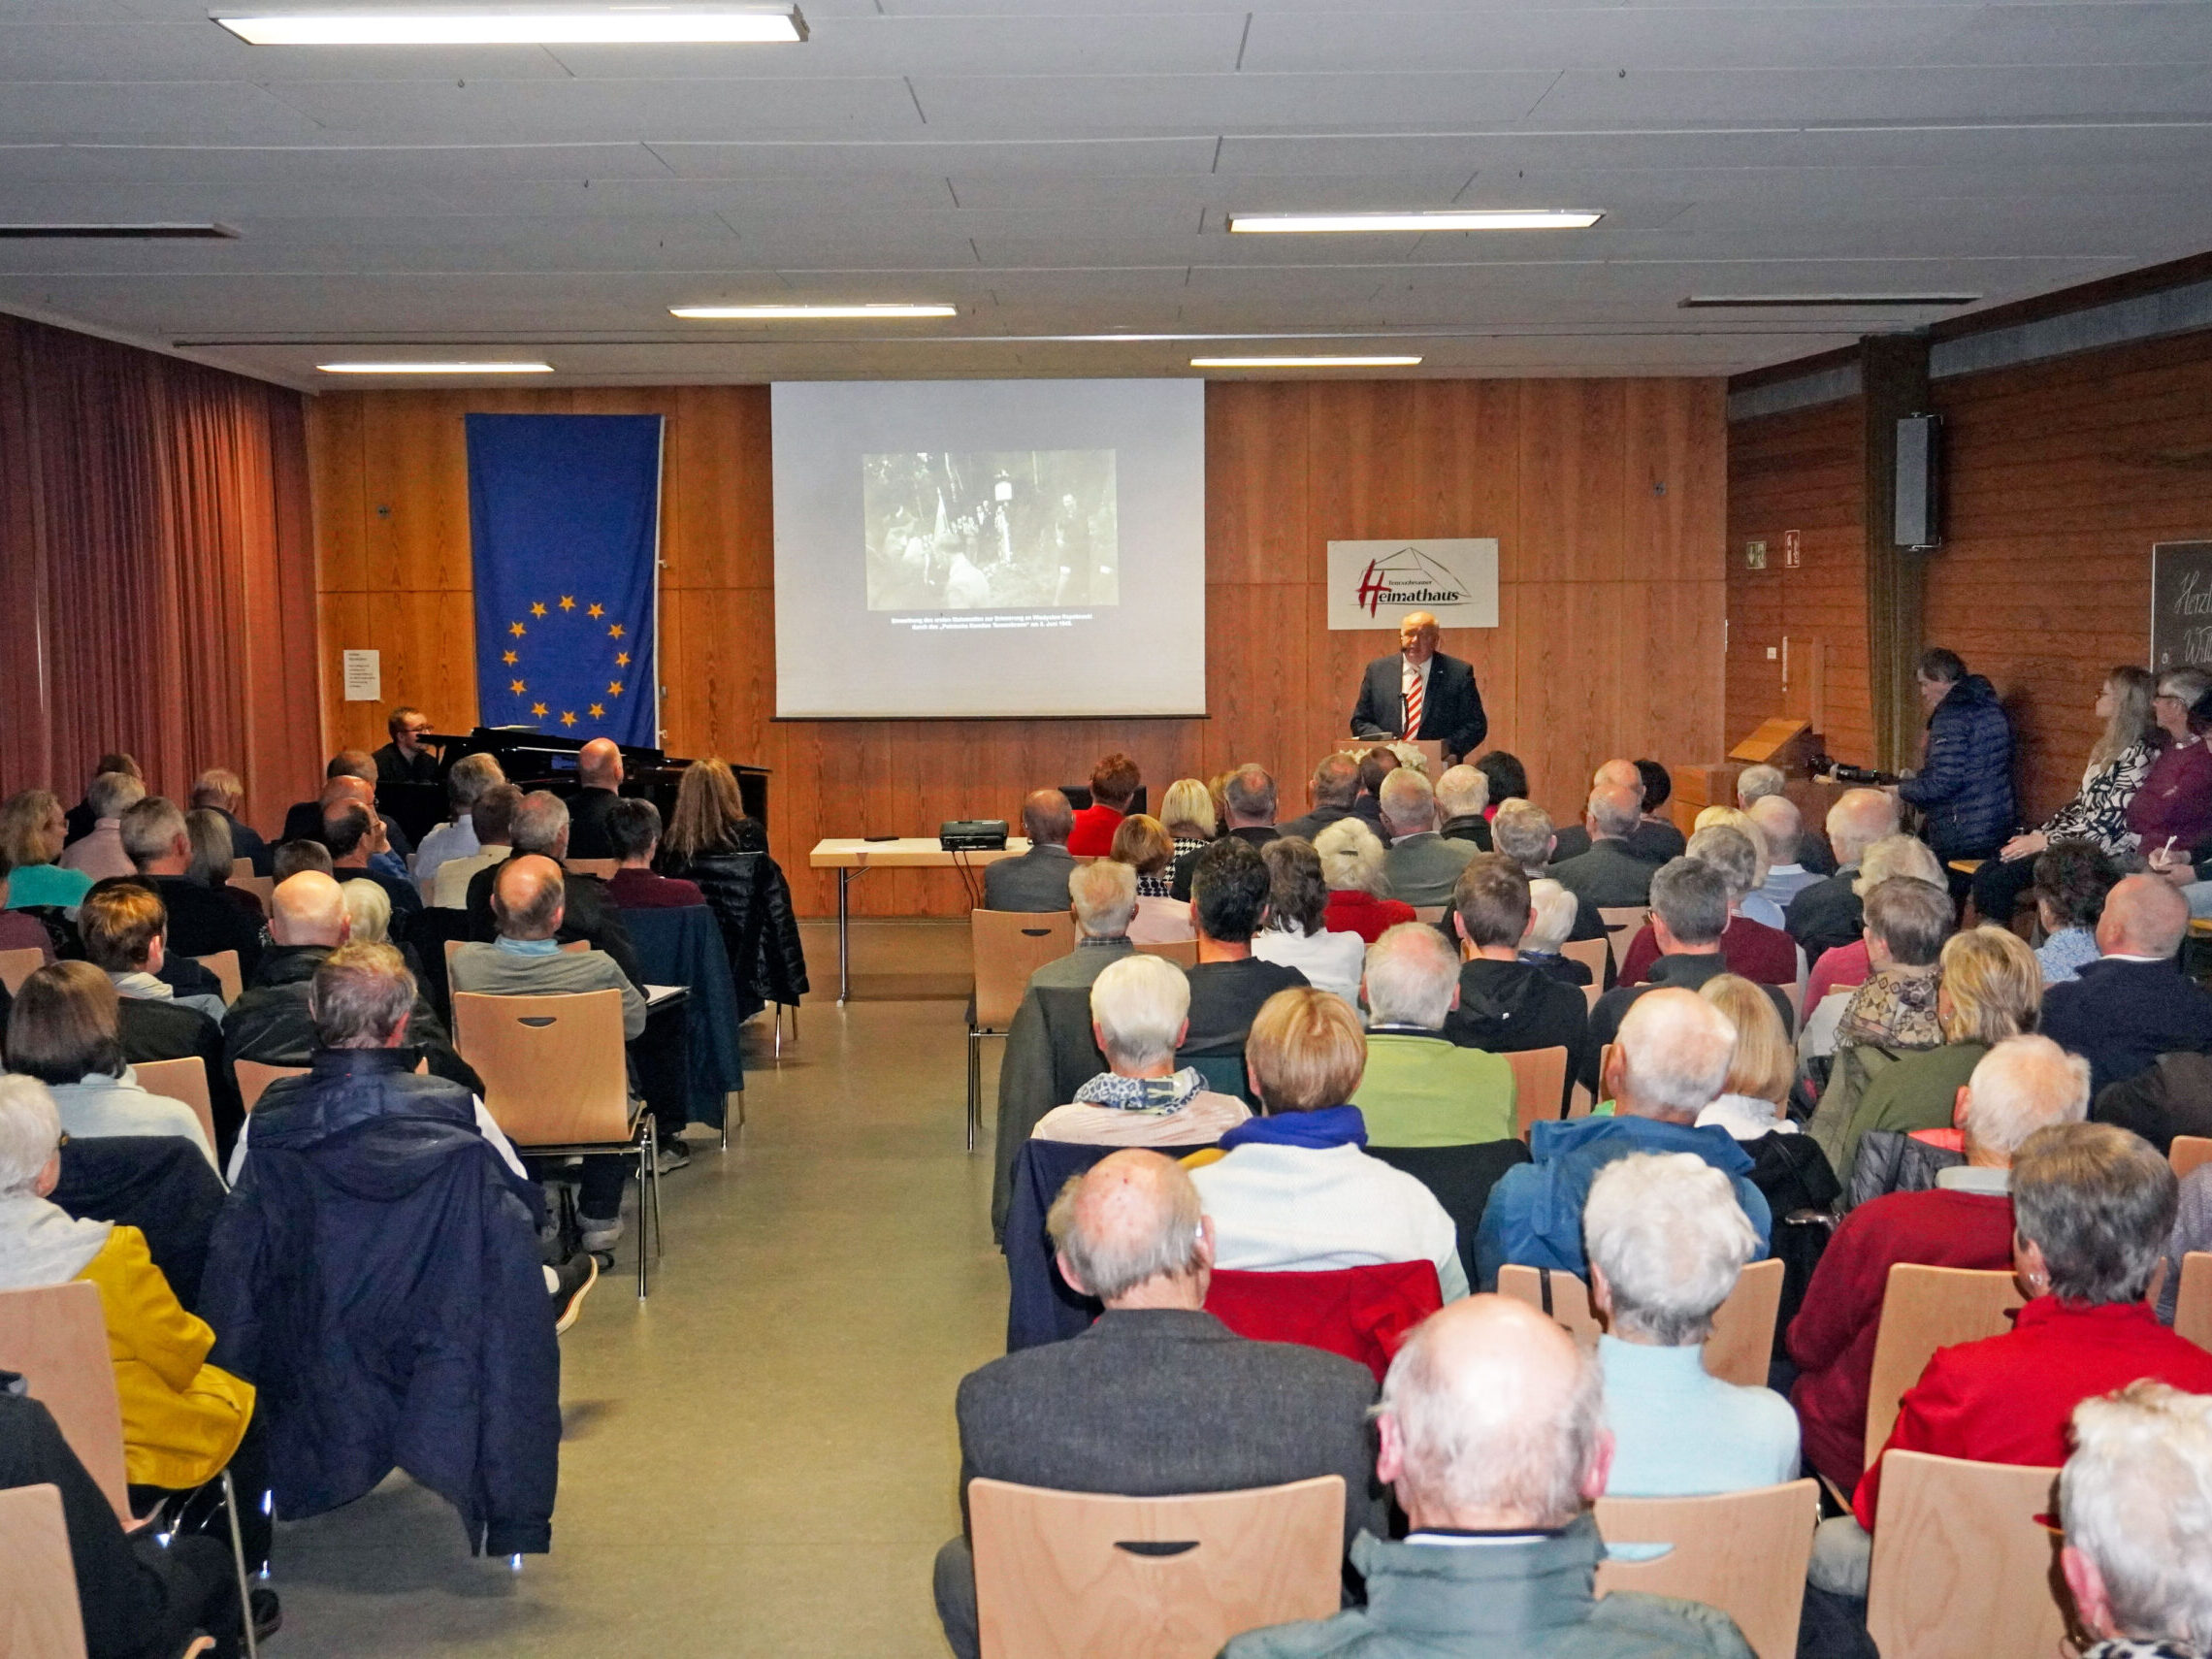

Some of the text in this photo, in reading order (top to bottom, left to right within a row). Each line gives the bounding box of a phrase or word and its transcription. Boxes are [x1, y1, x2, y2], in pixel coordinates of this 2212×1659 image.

[1354, 559, 1459, 618] Heimathaus
[2173, 569, 2212, 615] Herzl
[2184, 626, 2212, 665] Will
